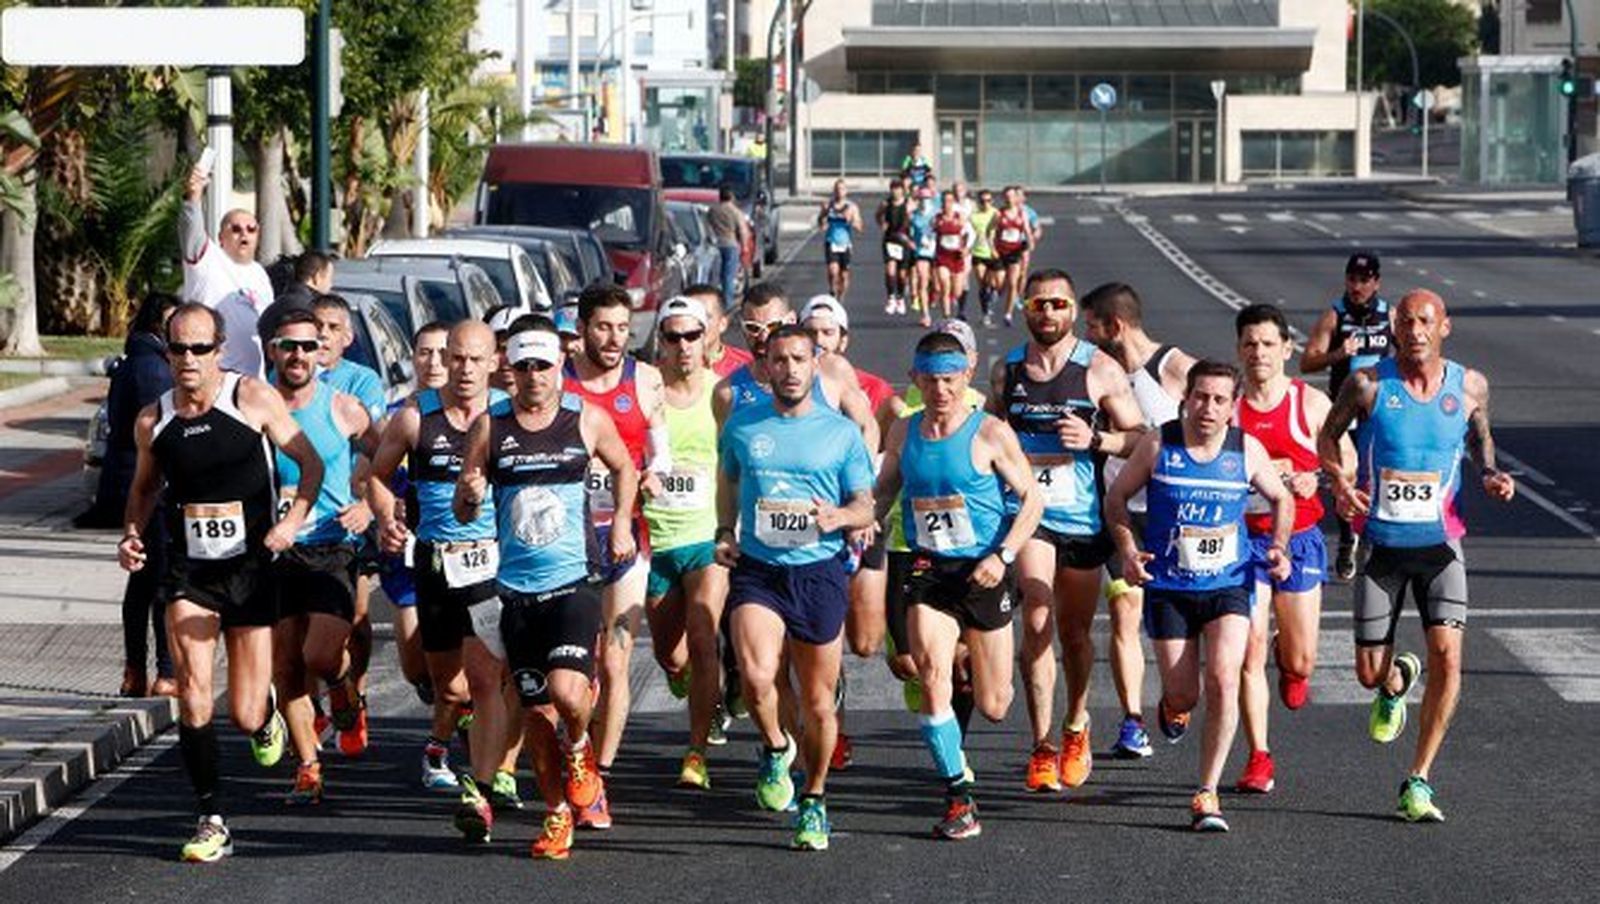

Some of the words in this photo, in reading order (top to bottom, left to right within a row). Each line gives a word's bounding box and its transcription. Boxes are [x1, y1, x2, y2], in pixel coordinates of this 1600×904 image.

[1038, 468, 1053, 486] 4
[1386, 484, 1432, 502] 363
[191, 519, 237, 538] 189
[769, 512, 809, 531] 1020
[924, 511, 954, 532] 21
